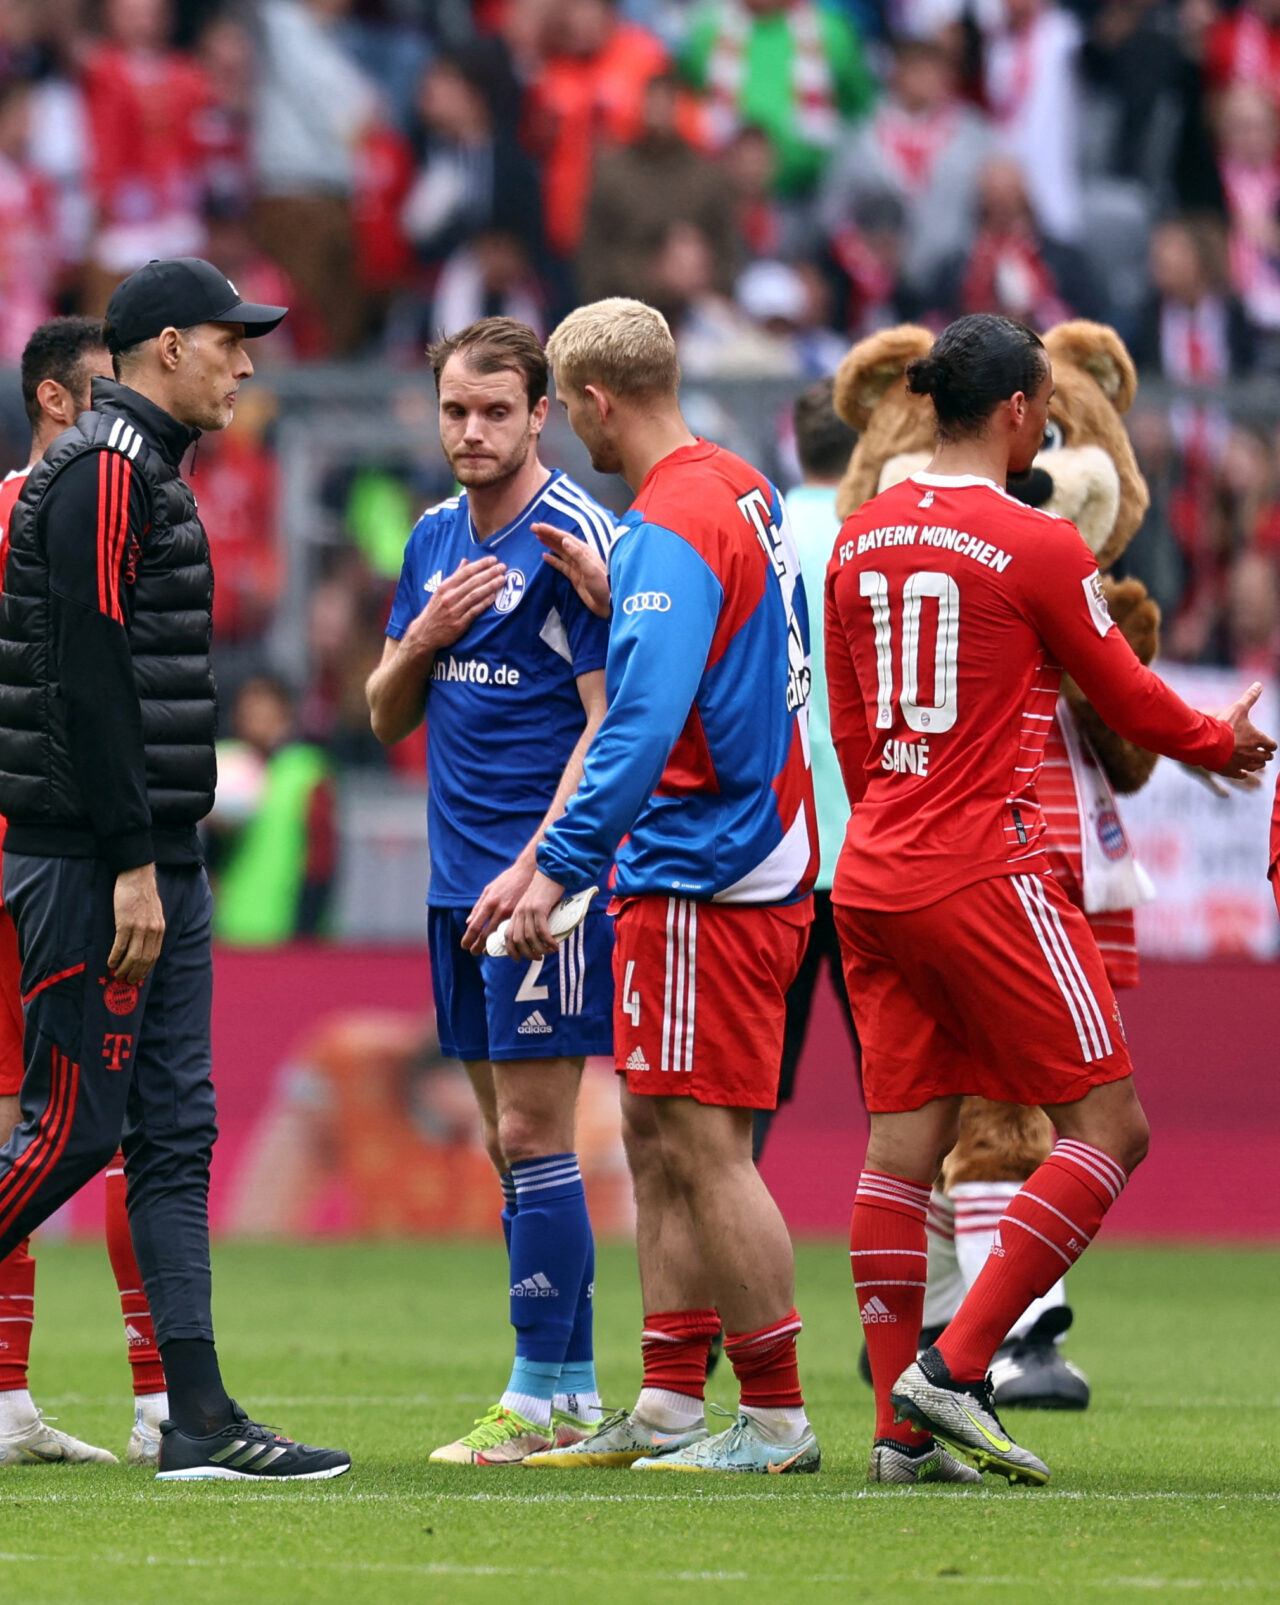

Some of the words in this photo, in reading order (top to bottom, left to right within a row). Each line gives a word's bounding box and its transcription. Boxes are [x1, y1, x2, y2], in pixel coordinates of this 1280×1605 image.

[839, 541, 854, 566] FC
[856, 525, 918, 555] BAYERN
[859, 571, 960, 734] 10
[623, 960, 640, 1027] 4
[517, 1024, 552, 1034] adidas
